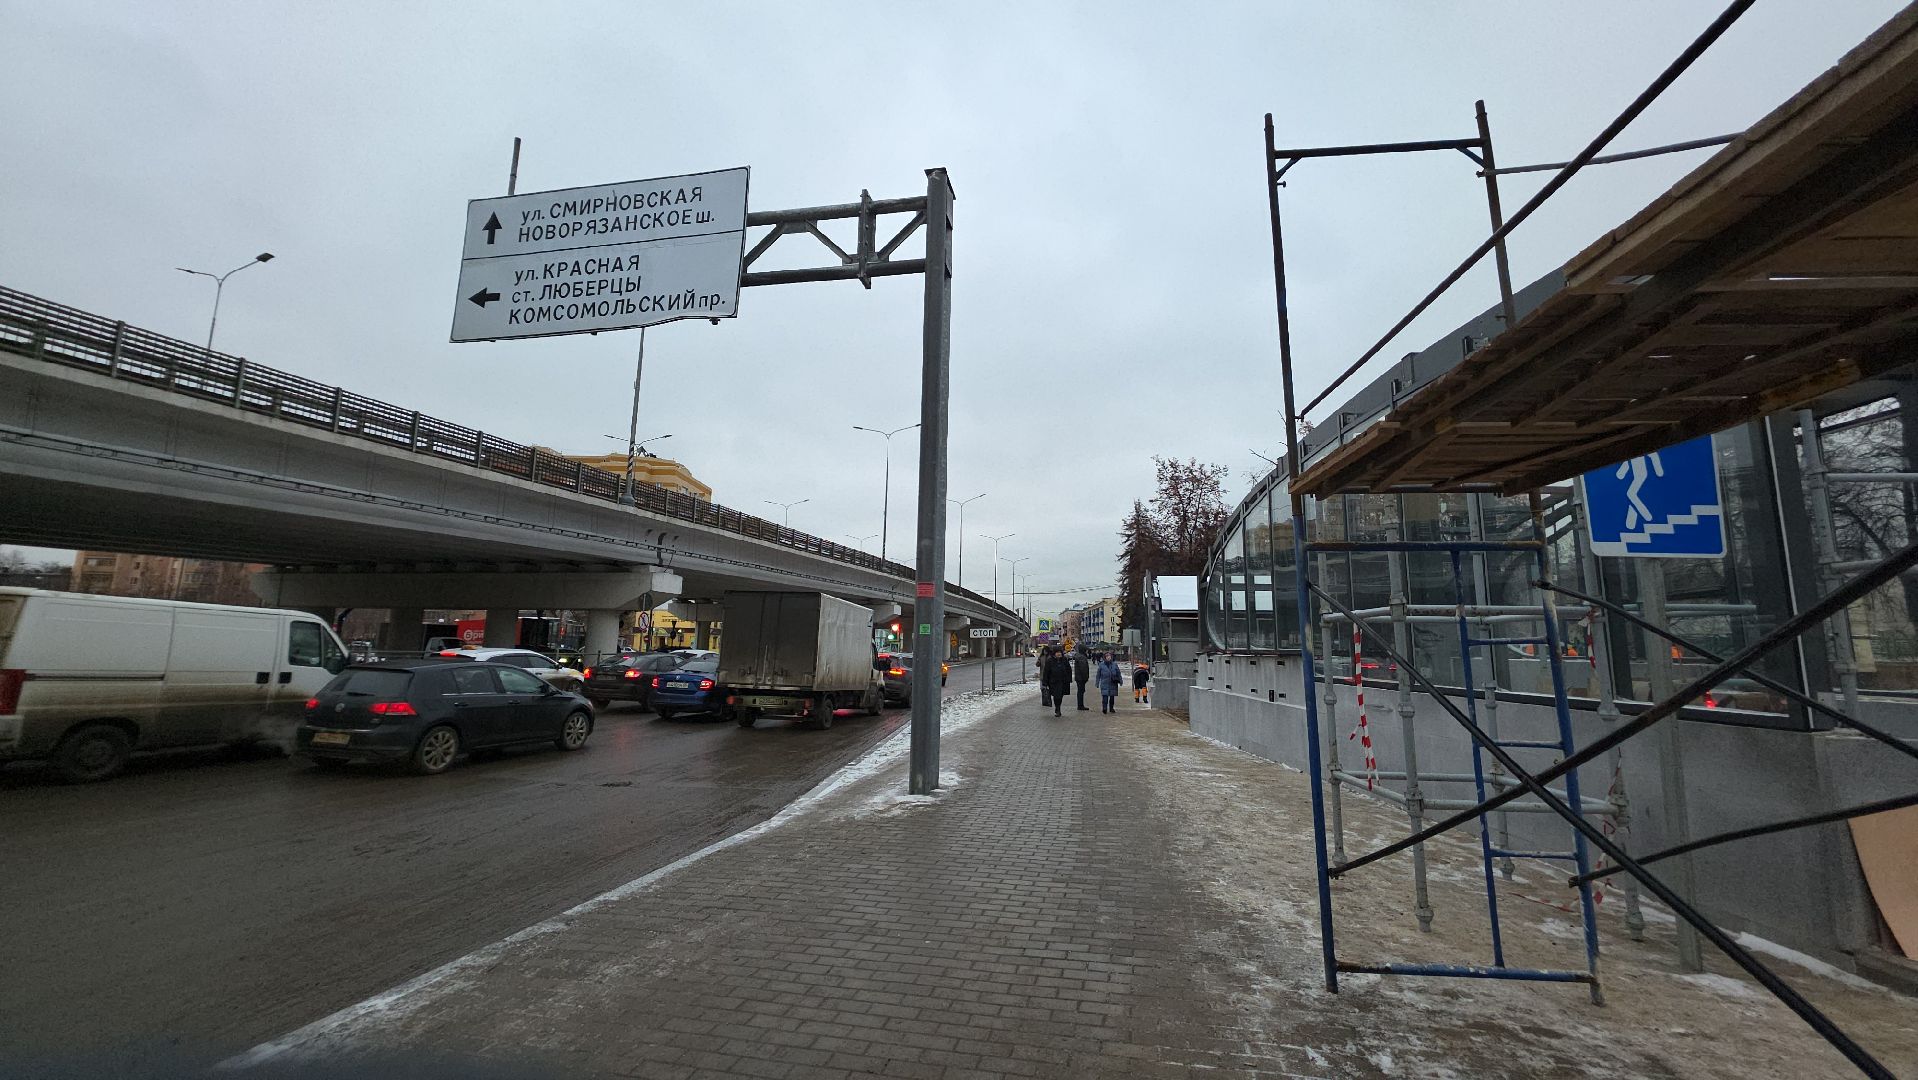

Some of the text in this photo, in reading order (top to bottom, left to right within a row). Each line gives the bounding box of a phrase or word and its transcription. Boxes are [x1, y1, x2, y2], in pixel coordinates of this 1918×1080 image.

[521, 186, 703, 226] ул. СМИРНОВСКАЯ
[518, 208, 716, 243] НОВОРЯЗАНСКОЕ ш.
[514, 254, 640, 286] ул. КРАСНАЯ
[511, 275, 642, 303] ст. ЛЮБЕРЦЫ
[508, 289, 726, 325] КОМСОМОЛЬСКИЙ пр.
[973, 629, 994, 637] СТОП
